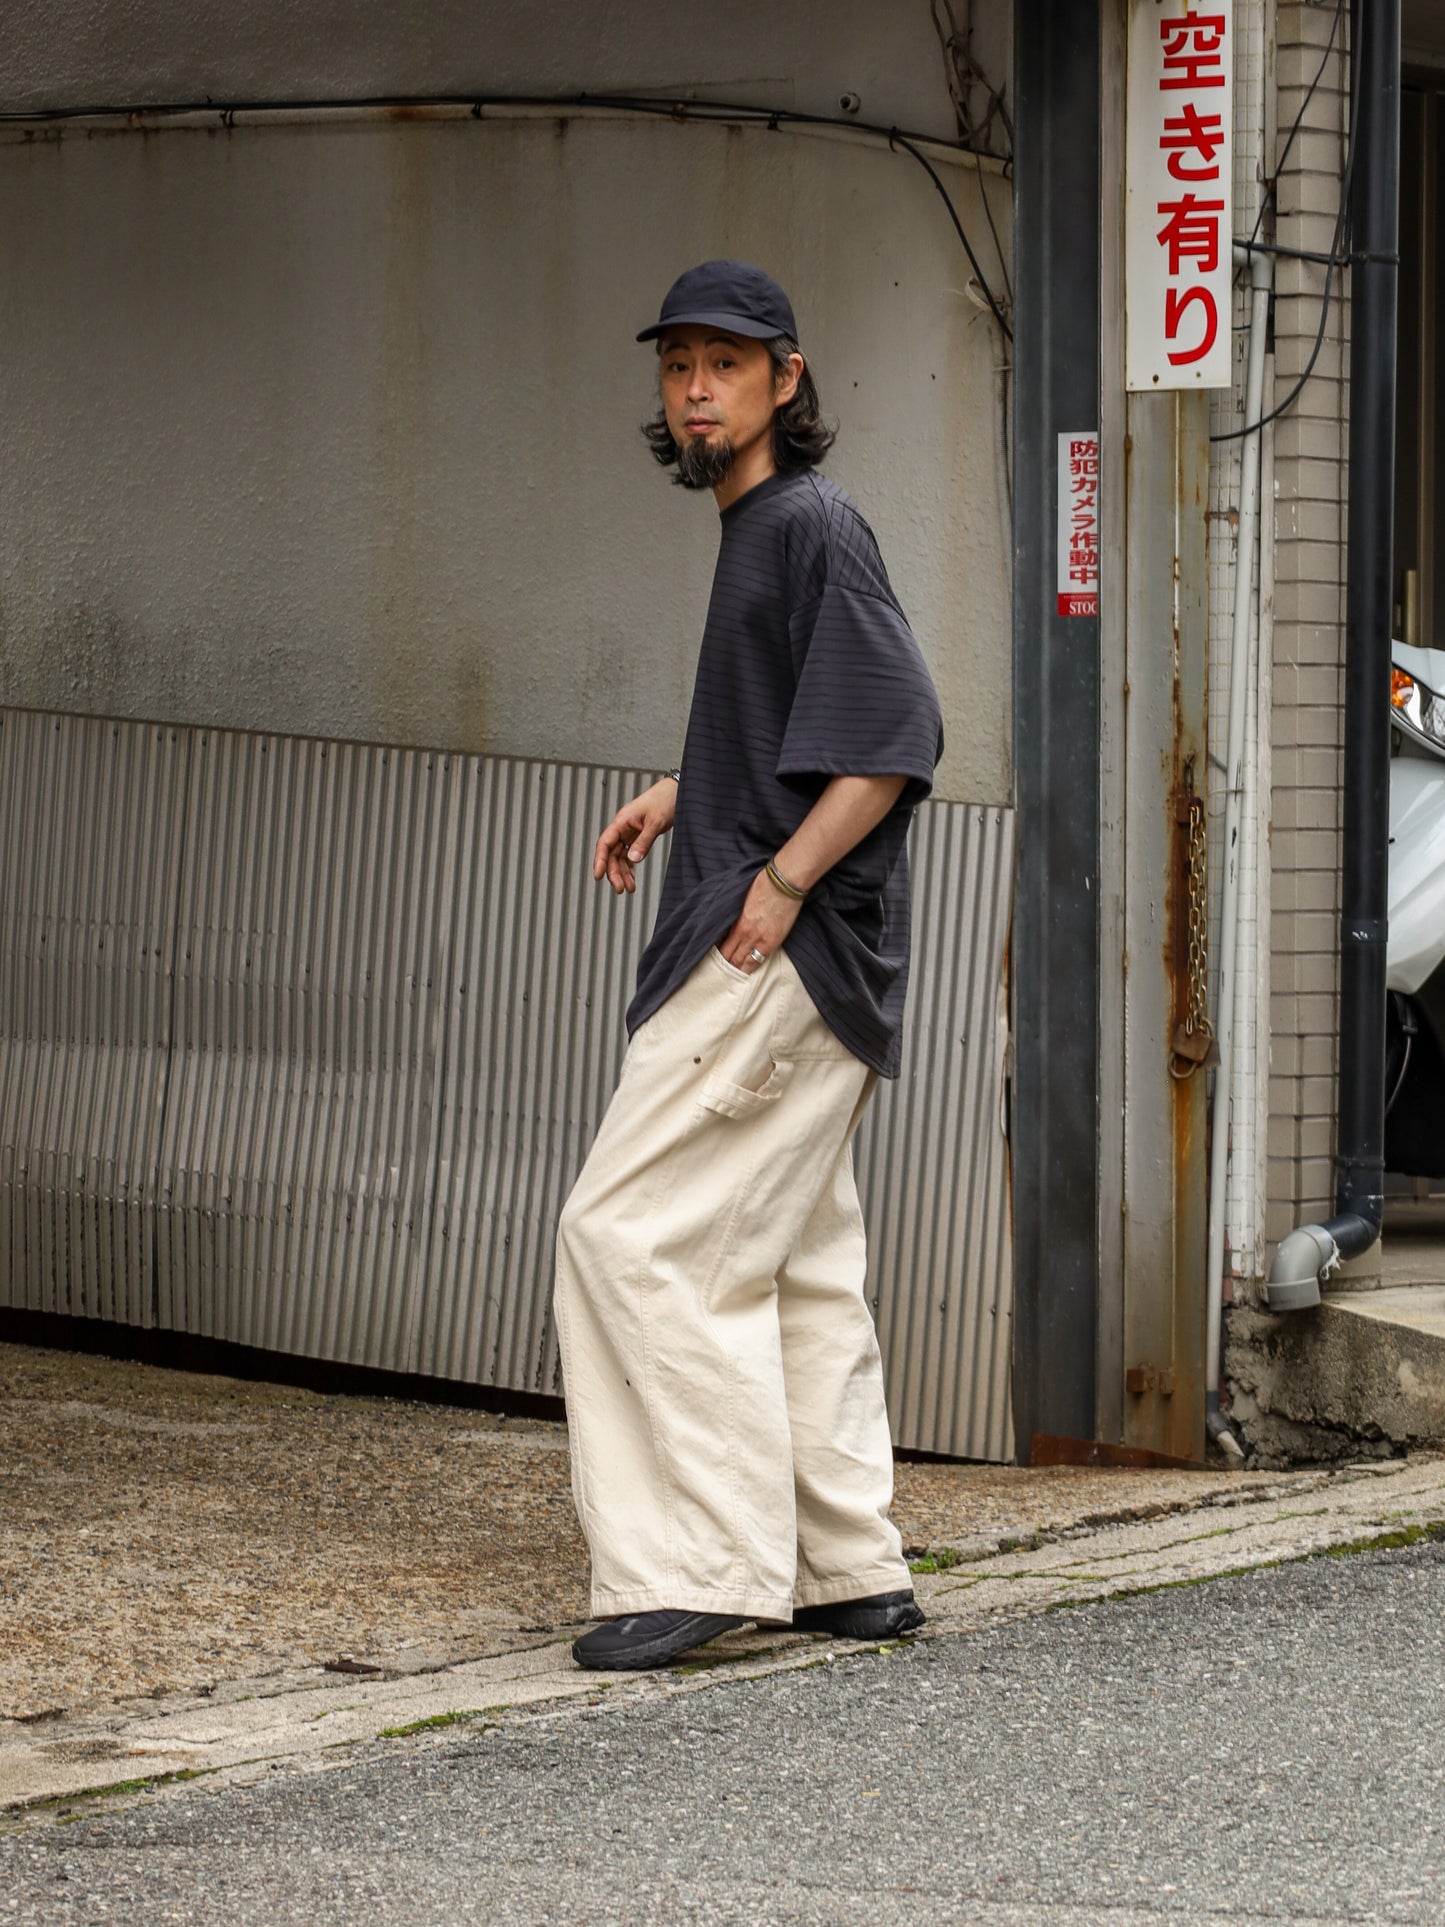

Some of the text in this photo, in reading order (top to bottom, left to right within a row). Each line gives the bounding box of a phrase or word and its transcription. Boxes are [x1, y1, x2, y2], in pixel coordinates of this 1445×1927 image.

[1157, 10, 1225, 366] 空き有り
[1069, 439, 1098, 584] 防犯カメラ作動中
